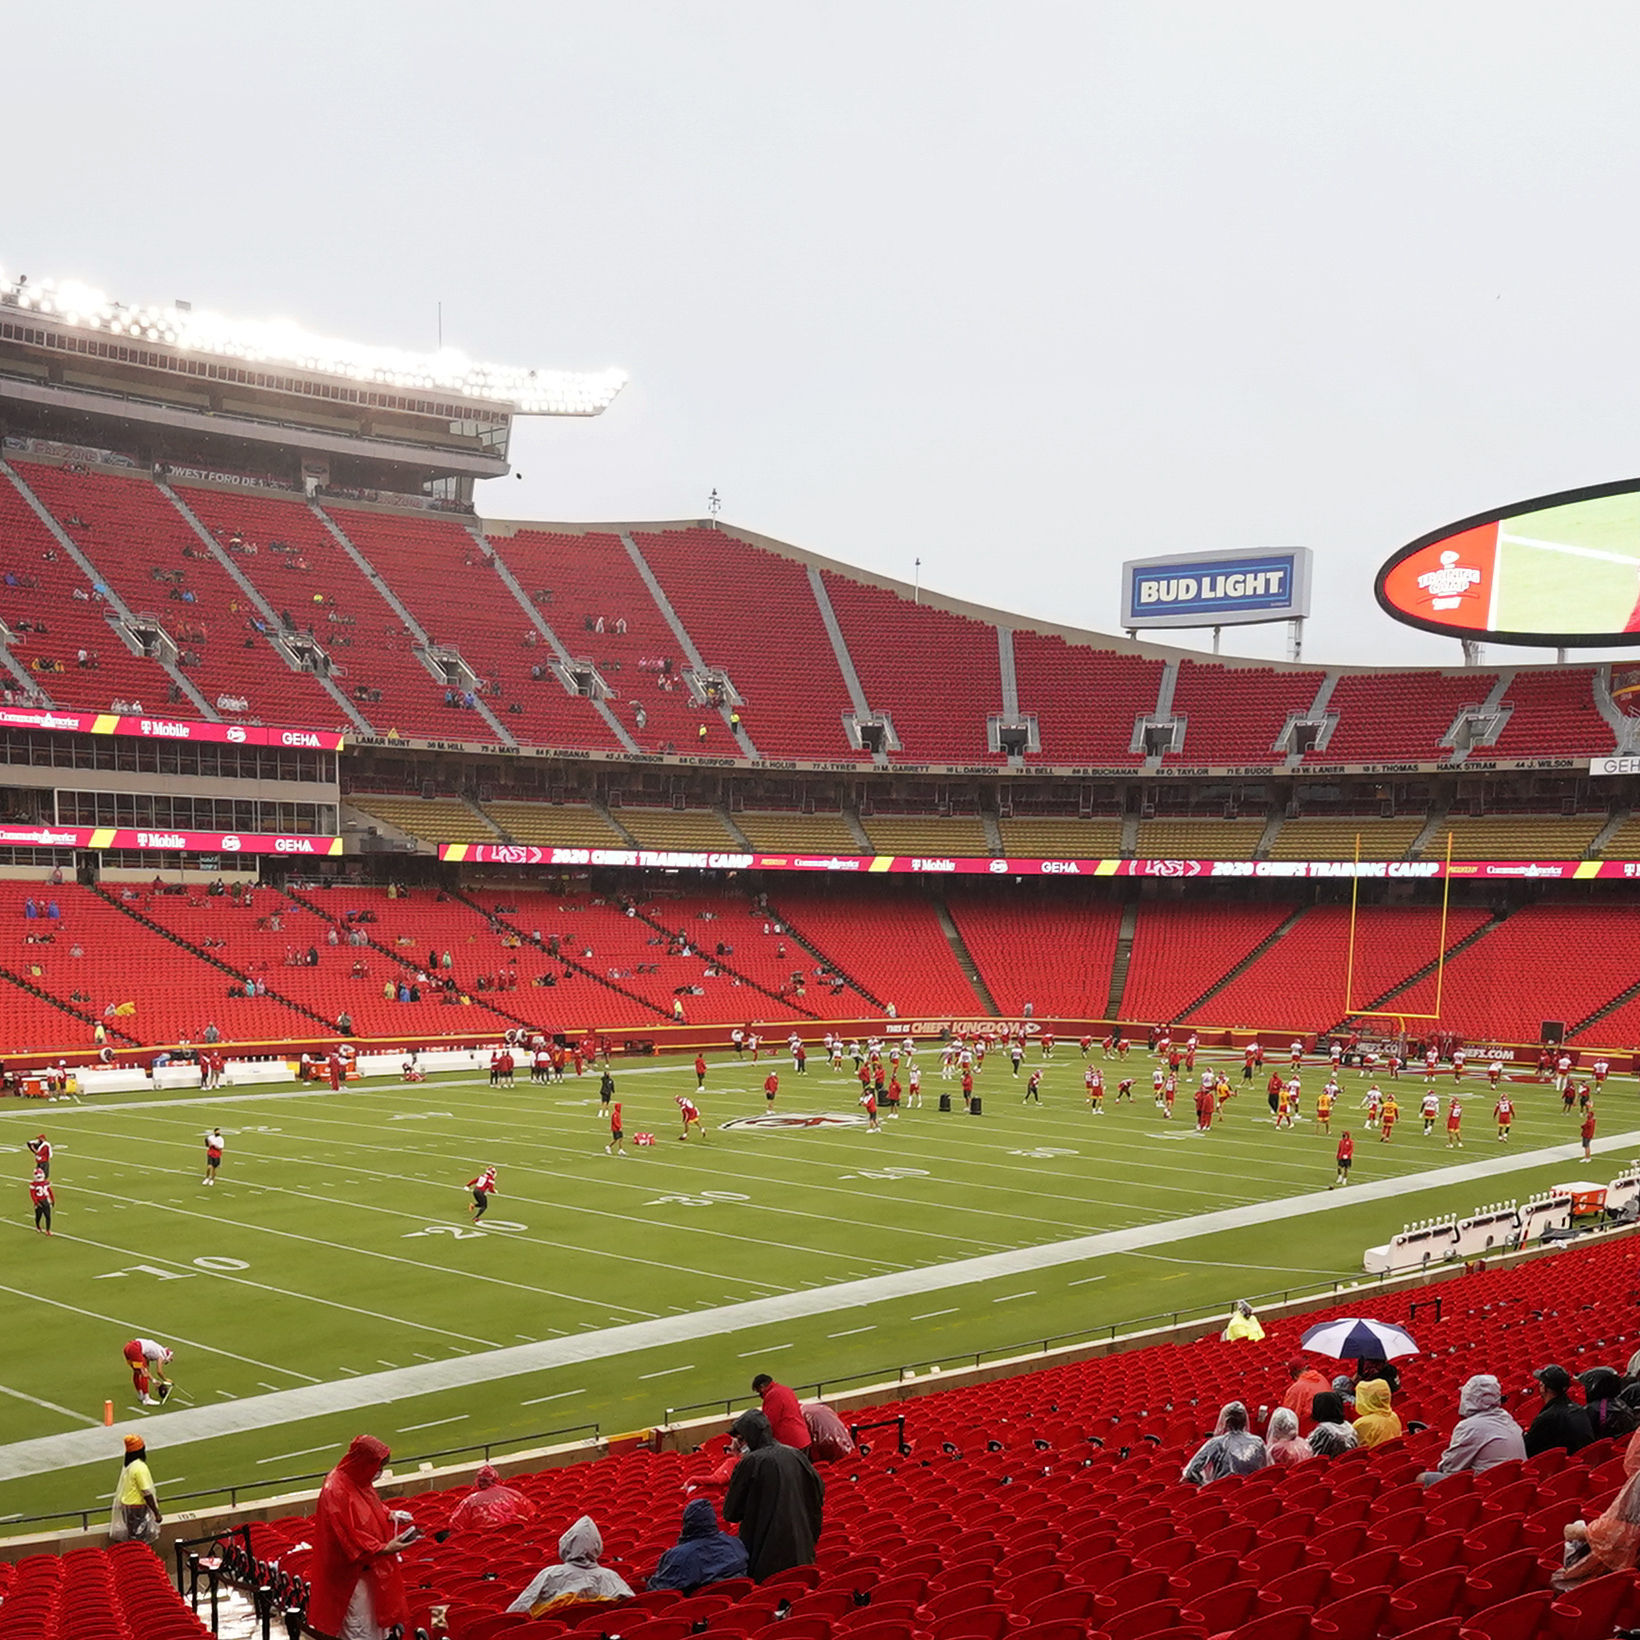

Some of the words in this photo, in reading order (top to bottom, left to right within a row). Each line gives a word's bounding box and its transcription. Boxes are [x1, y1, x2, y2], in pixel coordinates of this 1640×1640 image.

[208, 471, 240, 485] FORD
[1141, 578, 1198, 603] BUD
[1201, 571, 1283, 599] LIGHT
[153, 723, 190, 737] Mobile
[282, 732, 321, 747] GEHA
[356, 737, 385, 747] LAMAR
[388, 738, 411, 748] HUNT
[448, 743, 464, 751] HILL
[623, 753, 664, 763] ROBINSON
[1382, 764, 1419, 772] THOMAS
[1437, 763, 1462, 771] HANK
[1464, 762, 1497, 770] STRAM
[1538, 760, 1573, 768] WILSON
[963, 767, 999, 775] DAWSON
[149, 835, 185, 848] Mobile
[275, 839, 313, 852] GEHA
[551, 849, 589, 864] 2020
[591, 850, 637, 865] CHIEFS
[639, 852, 708, 868] TRAINING
[710, 853, 753, 868] CAMP
[922, 860, 955, 871] Mobile
[1042, 862, 1079, 872] GEHA
[1211, 862, 1254, 876] 2020
[1256, 862, 1308, 876] CHIEFS
[1309, 863, 1387, 877] TRAINING
[1389, 863, 1439, 877] CAMP
[886, 1024, 902, 1033] THIS
[903, 1024, 909, 1032] IS
[912, 1022, 951, 1033] CHIEFS
[424, 1219, 528, 1240] 20
